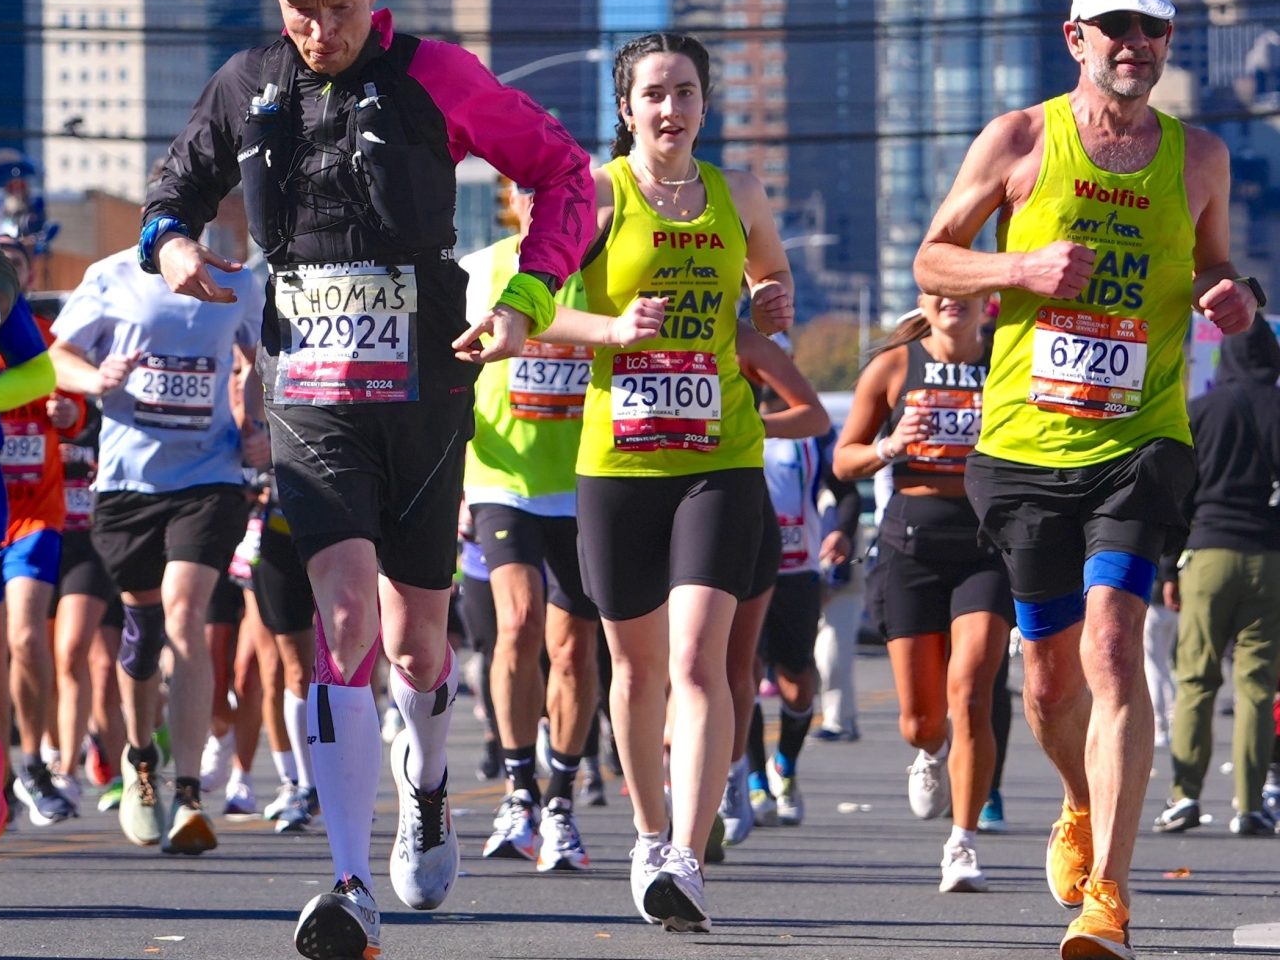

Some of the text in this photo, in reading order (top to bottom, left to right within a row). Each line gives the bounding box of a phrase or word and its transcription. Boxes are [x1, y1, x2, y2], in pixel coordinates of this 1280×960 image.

[1074, 178, 1151, 210] Wolfie
[652, 231, 725, 250] PIPPA
[1094, 250, 1151, 280] AM
[281, 283, 407, 316] THOMAS
[1051, 311, 1074, 329] tcs
[297, 314, 400, 350] 22924
[1116, 329, 1135, 338] TATA
[352, 351, 359, 359] D
[626, 356, 648, 369] tcs
[1050, 336, 1129, 377] 6720
[516, 360, 590, 385] 43772
[1104, 376, 1111, 384] C
[142, 371, 211, 398] 23885
[366, 380, 393, 390] 2024
[621, 376, 713, 408] 25160
[675, 409, 681, 417] E
[1104, 403, 1128, 413] 2024
[929, 410, 981, 436] 432
[684, 433, 710, 444] 2024
